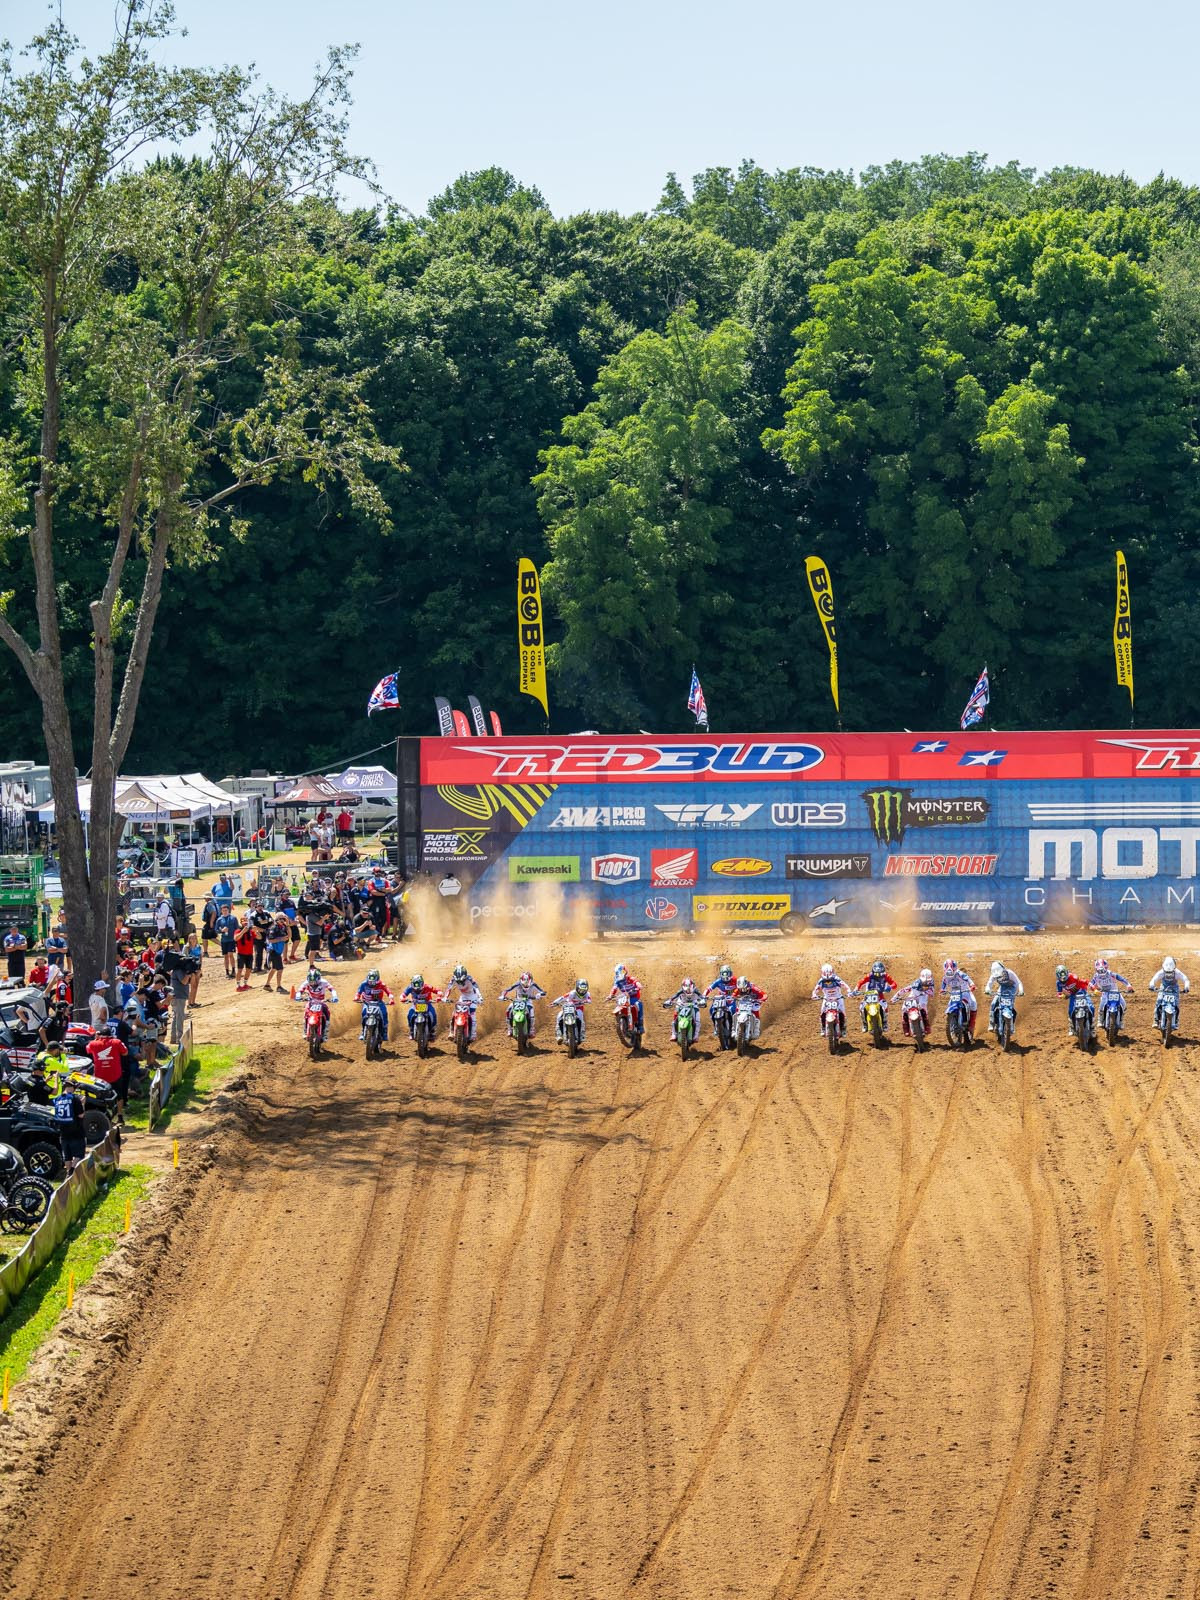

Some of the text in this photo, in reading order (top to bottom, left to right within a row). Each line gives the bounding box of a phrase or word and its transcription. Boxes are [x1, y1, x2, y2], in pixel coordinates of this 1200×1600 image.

[521, 571, 541, 647] BOB
[612, 807, 646, 820] PRO
[654, 803, 764, 822] FLY
[907, 800, 985, 814] MONSTER
[548, 806, 610, 828] AMA
[771, 803, 846, 826] WPS
[454, 832, 487, 855] X
[517, 864, 572, 875] Kawasaki
[598, 860, 633, 877] 100%
[713, 858, 772, 872] FMF
[787, 859, 852, 875] TRIUMPH
[647, 897, 668, 920] VP
[711, 901, 787, 911] DUNLOP
[911, 901, 995, 911] LANDMASTER
[514, 1002, 526, 1010] 29
[680, 1007, 692, 1016] 47
[825, 1002, 838, 1010] 39
[58, 1104, 71, 1117] 51
